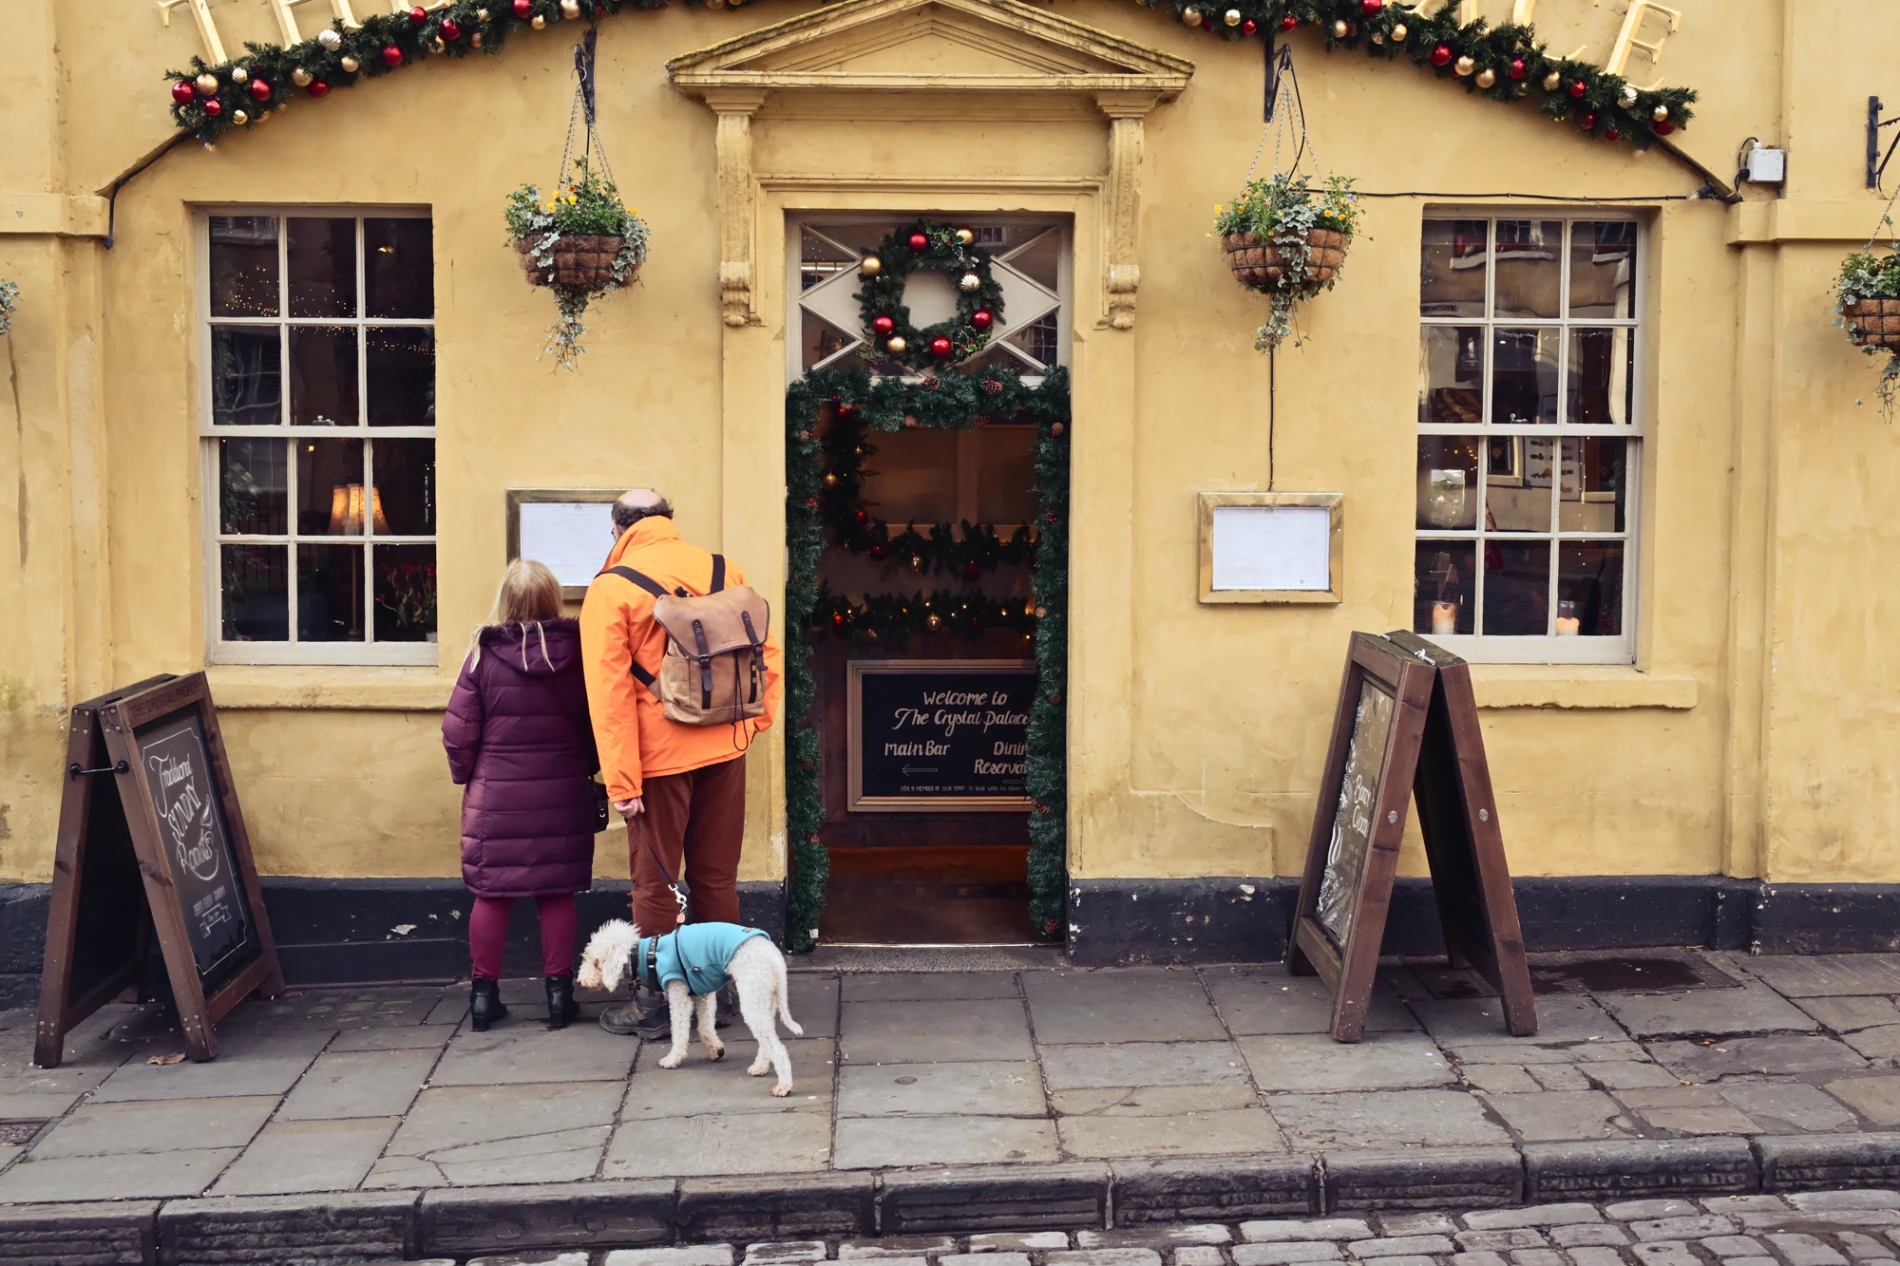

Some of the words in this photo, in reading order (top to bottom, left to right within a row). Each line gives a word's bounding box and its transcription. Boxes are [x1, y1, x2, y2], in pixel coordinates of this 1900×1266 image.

[923, 690, 988, 705] Welcome
[991, 691, 1008, 705] to
[891, 708, 929, 730] The
[934, 709, 982, 737] Crystal
[884, 741, 924, 756] Main
[925, 740, 950, 756] Bar
[974, 759, 1027, 775] Reserva
[168, 775, 202, 842] SUNDAY
